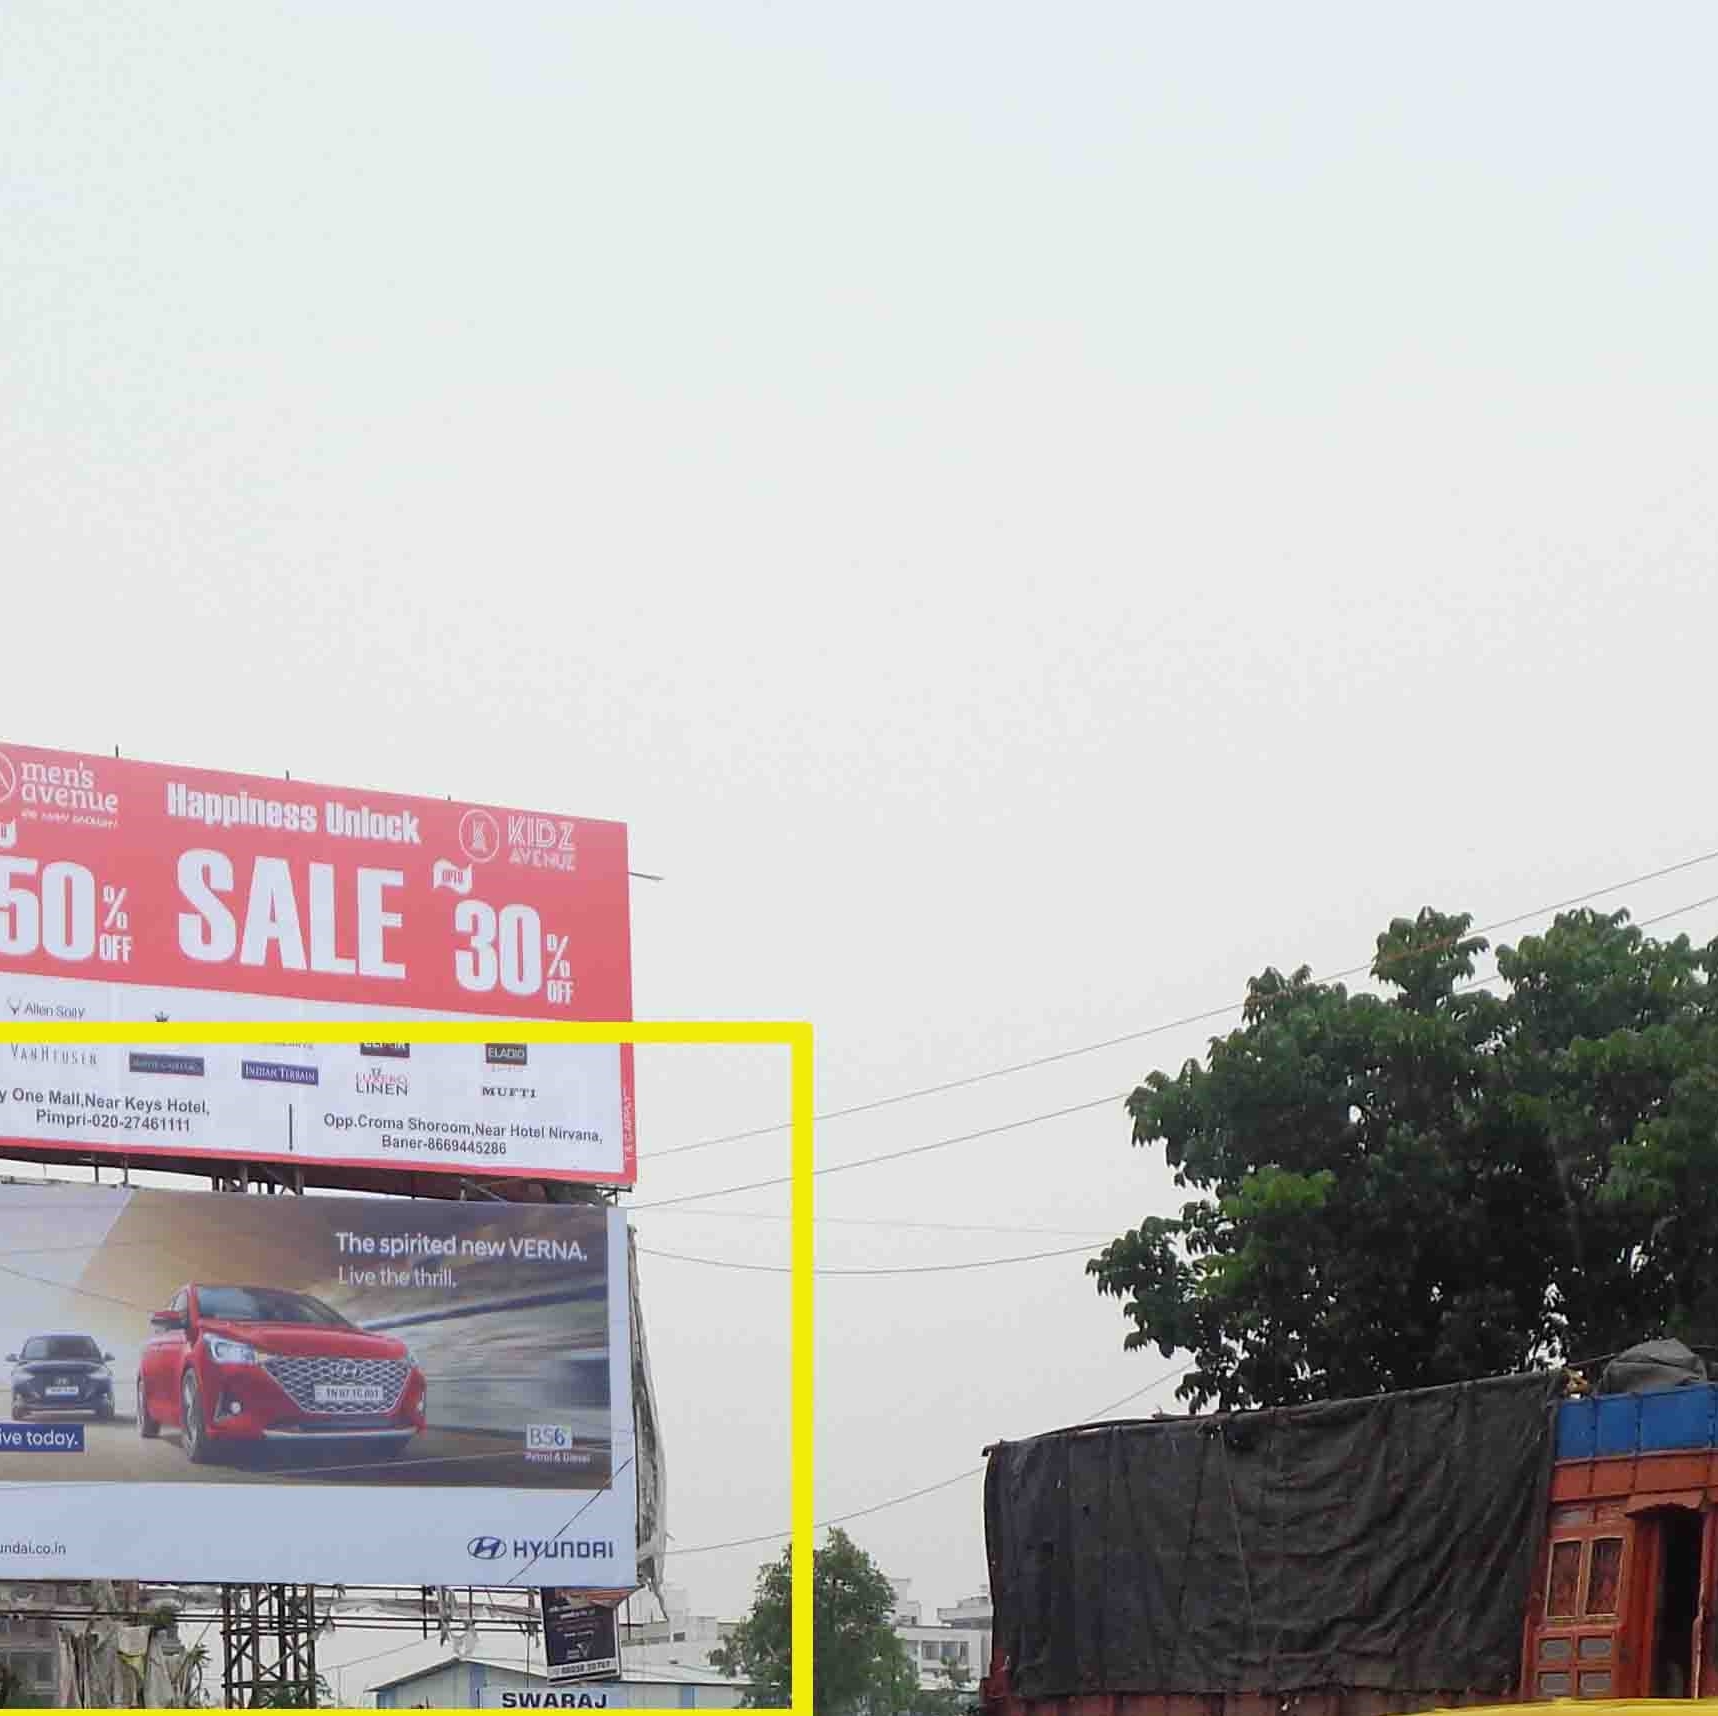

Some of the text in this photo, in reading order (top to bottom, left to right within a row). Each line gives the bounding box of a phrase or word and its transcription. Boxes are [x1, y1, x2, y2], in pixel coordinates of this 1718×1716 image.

[20, 759, 94, 790] men's
[21, 784, 118, 815] avenue
[167, 783, 317, 832] Happiness
[325, 802, 421, 844] Unlock
[507, 815, 576, 850] KIDZ
[509, 847, 576, 872] AVENUE
[176, 848, 407, 980] SALE
[99, 934, 133, 964] OFF
[547, 979, 574, 1005] OFF
[245, 1064, 315, 1081] INDIAN TERRAIN
[12, 1087, 44, 1103] One
[125, 1097, 163, 1113] Keys
[167, 1098, 211, 1116] Hotel,
[356, 1083, 409, 1096] LINEN
[482, 1086, 537, 1098] MUFTI
[510, 1124, 545, 1139] Hotel
[548, 1128, 604, 1144] Nirvana,
[336, 1232, 589, 1262] The spirited new VERNA.
[338, 1266, 458, 1288] Live the thrill.
[26, 1430, 79, 1449] today.
[529, 1426, 566, 1446] BS6
[513, 1541, 614, 1559] HYUNDAI
[502, 1692, 608, 1709] SWARAJ
